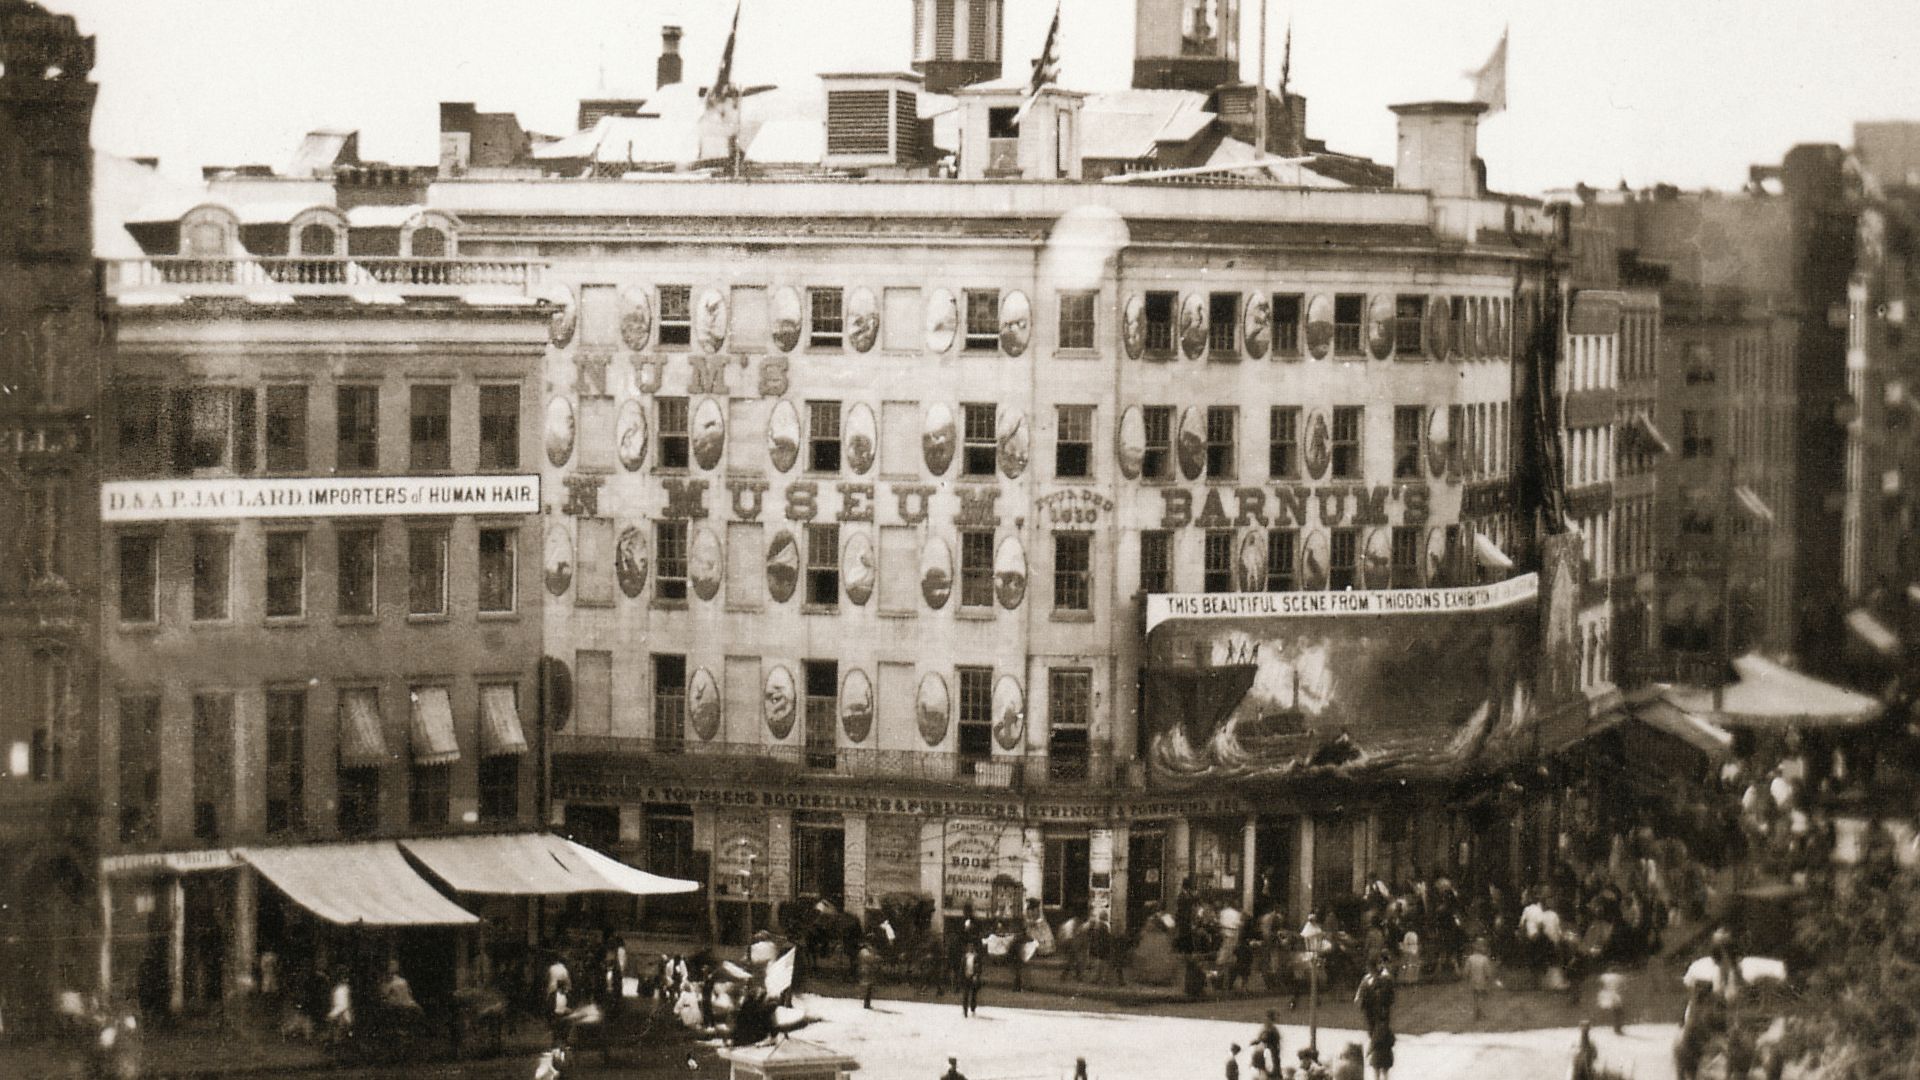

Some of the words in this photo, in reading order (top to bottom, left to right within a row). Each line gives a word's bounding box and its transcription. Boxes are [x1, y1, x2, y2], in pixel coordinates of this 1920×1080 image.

[309, 486, 407, 506] IMPORTERS
[411, 487, 424, 504] of
[429, 486, 486, 504] HUMAN
[1160, 486, 1431, 528] BARNUM'S
[1167, 597, 1199, 614] THIS
[1202, 596, 1278, 614] BEAUTIFUL
[1282, 595, 1327, 613] SCENE
[1331, 594, 1369, 612] FROM
